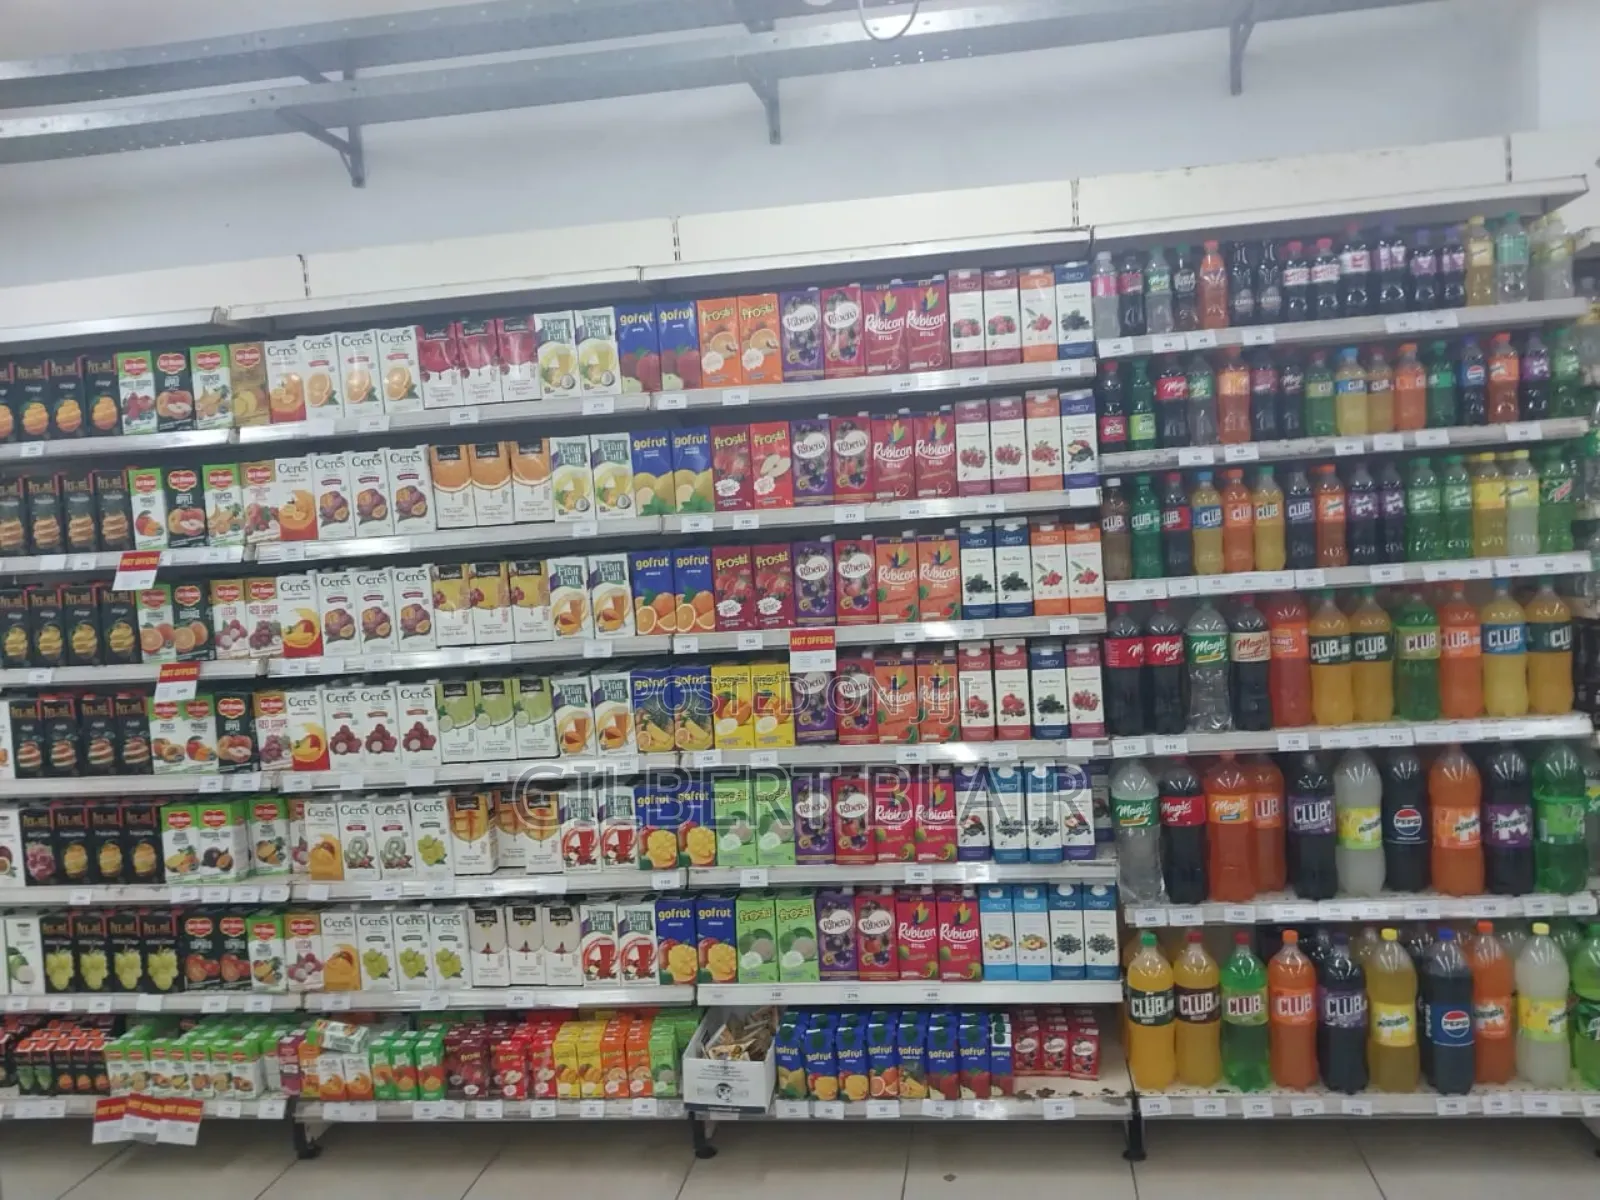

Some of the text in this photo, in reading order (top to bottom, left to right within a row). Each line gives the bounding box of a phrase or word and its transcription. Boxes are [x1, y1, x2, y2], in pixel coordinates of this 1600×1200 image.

[620, 310, 654, 324] gofrut
[660, 308, 694, 322] gofrut
[865, 313, 904, 331] Rubicon
[906, 309, 946, 328] Rubicon
[303, 336, 333, 350] Ceres
[341, 333, 373, 347] Ceres
[380, 330, 412, 343] Ceres
[267, 343, 298, 357] Ceres
[634, 437, 667, 450] gofrut
[674, 434, 708, 446] gofrut
[915, 438, 954, 456] Rubicon
[874, 441, 912, 458] Rubicon
[315, 458, 346, 470] Ceres
[352, 455, 383, 467] Ceres
[390, 452, 422, 464] Ceres
[279, 462, 309, 474] Ceres
[1201, 508, 1221, 524] CLUB
[1256, 503, 1278, 520] CLUB
[1289, 501, 1312, 518] CLUB
[1102, 515, 1124, 530] CLUB
[1131, 513, 1153, 529] CLUB
[636, 557, 669, 571] gofrut
[676, 554, 709, 568] gofrut
[878, 563, 917, 580] Rubicon
[920, 560, 958, 577] Rubicon
[321, 577, 351, 589] Ceres
[357, 574, 387, 586] Ceres
[396, 571, 427, 583] Ceres
[280, 583, 311, 595] Ceres
[791, 636, 834, 646] HOT OFFERS
[1406, 631, 1436, 651] CLUB
[1488, 627, 1521, 647] CLUB
[1311, 640, 1337, 658] CLUB
[1355, 635, 1386, 656] CLUB
[326, 693, 357, 704] Ceres
[361, 691, 391, 701] Ceres
[401, 689, 432, 700] Ceres
[308, 807, 335, 818] Ceres
[340, 804, 369, 815] Ceres
[375, 804, 406, 816] Ceres
[414, 801, 444, 813] Ceres
[875, 805, 912, 822] Rubicon
[916, 805, 954, 822] Rubicon
[1116, 803, 1152, 819] Magic
[1293, 800, 1330, 823] CLUB
[1396, 817, 1422, 825] PEPSI
[658, 908, 691, 922] gofrut
[698, 907, 732, 919] gofrut
[324, 917, 353, 928] Ceres
[360, 916, 389, 926] Ceres
[396, 915, 426, 926] Ceres
[432, 916, 461, 926] Ceres
[898, 923, 936, 940] Rubicon
[940, 923, 978, 940] Rubicon
[1131, 996, 1163, 1017] CLUB
[1179, 992, 1213, 1015] CLUB
[1227, 995, 1261, 1016] CLUB
[1277, 993, 1312, 1016] CLUB
[1327, 995, 1362, 1016] CLUB
[1443, 1019, 1469, 1027] PEPSI
